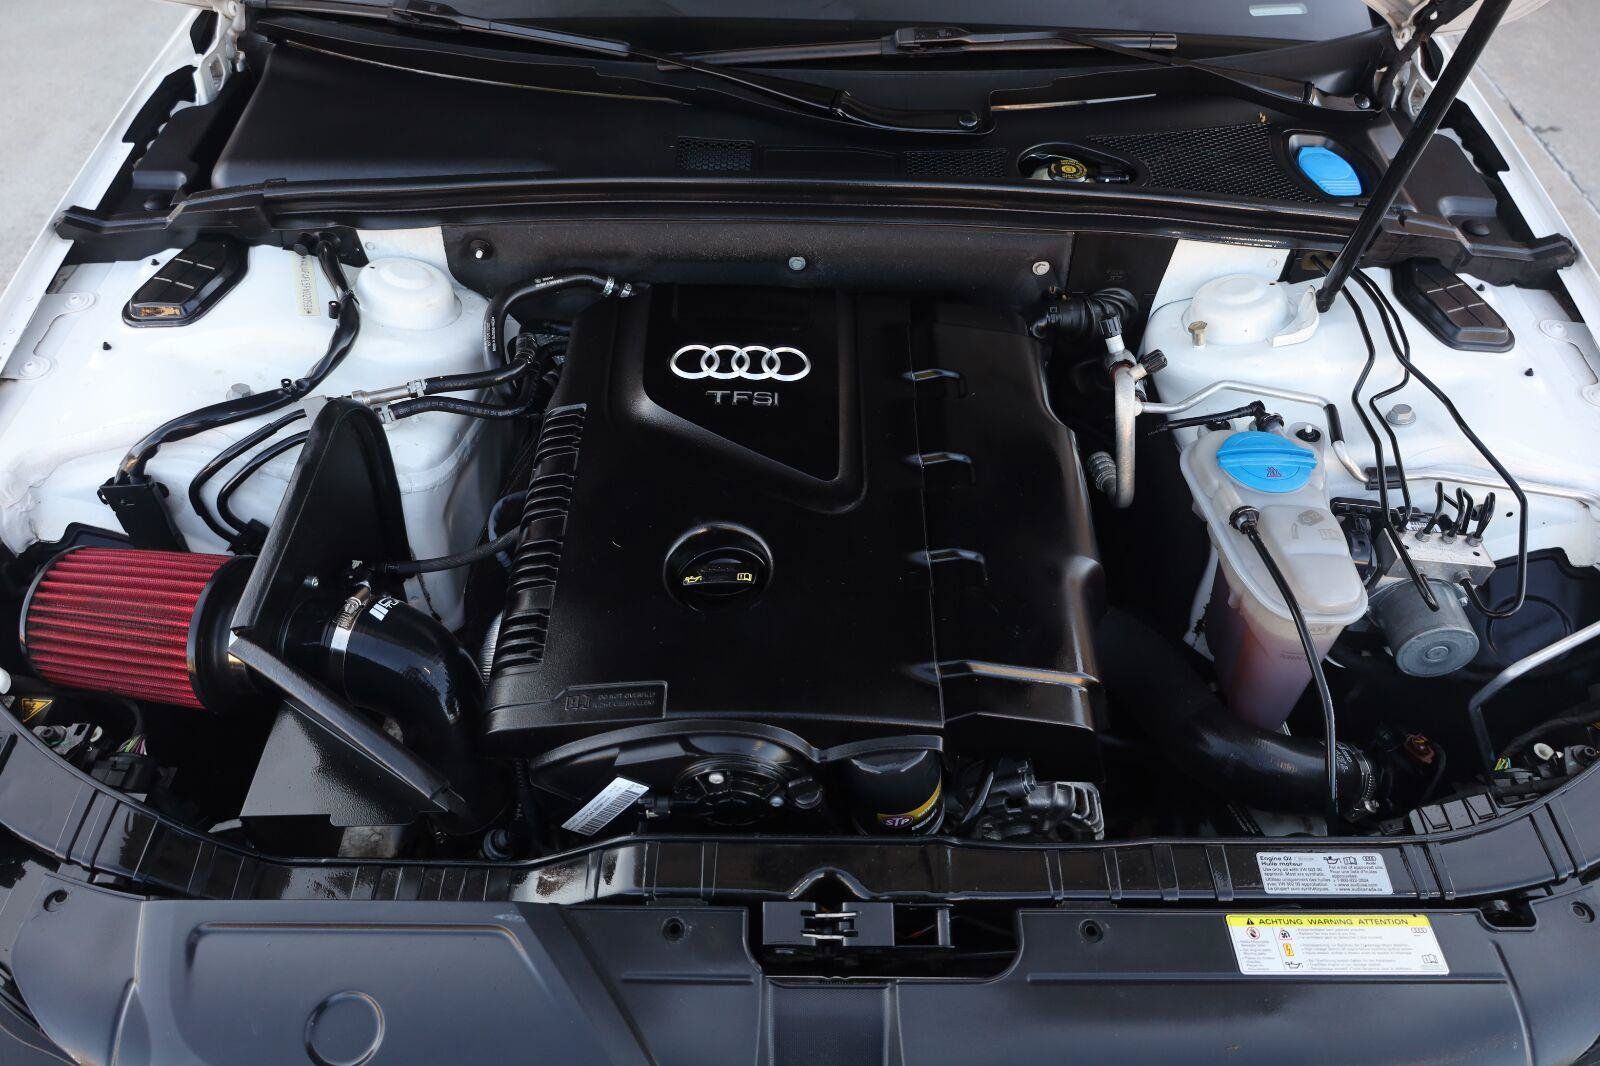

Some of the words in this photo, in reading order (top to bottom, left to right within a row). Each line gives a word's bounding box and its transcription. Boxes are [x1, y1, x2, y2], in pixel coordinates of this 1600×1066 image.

[705, 390, 779, 406] TFSI
[885, 817, 910, 827] STP
[1258, 918, 1303, 926] ACHTUNG
[1307, 918, 1353, 926] WARNING
[1358, 918, 1408, 926] ATTENTION
